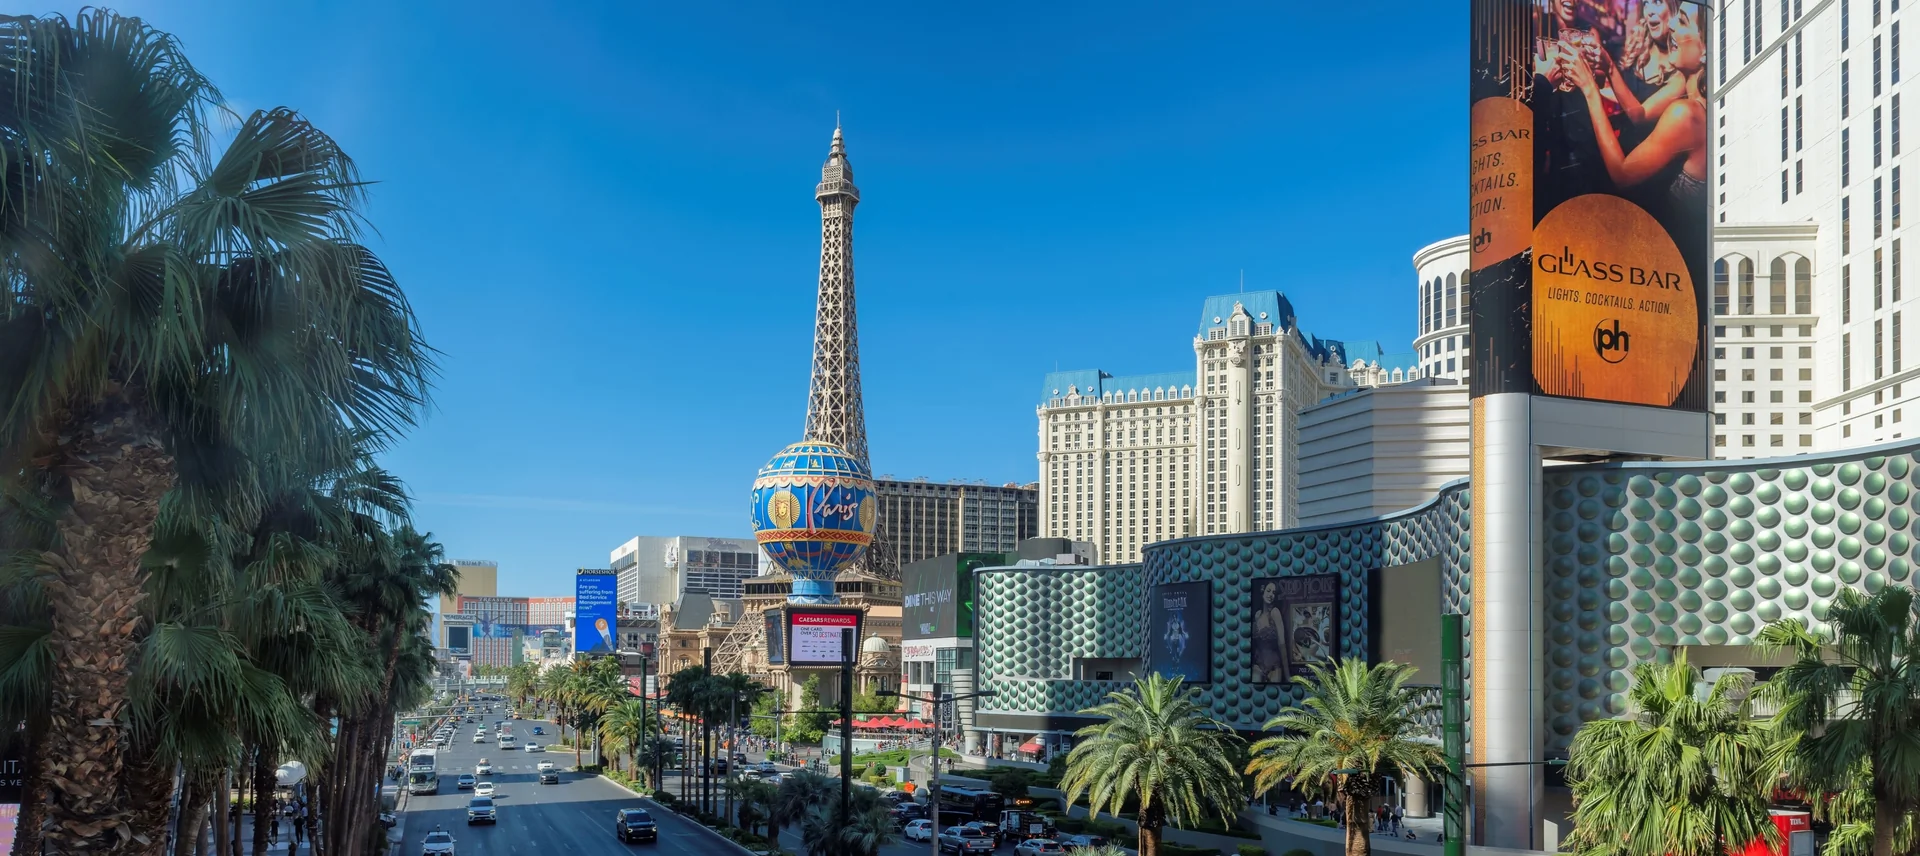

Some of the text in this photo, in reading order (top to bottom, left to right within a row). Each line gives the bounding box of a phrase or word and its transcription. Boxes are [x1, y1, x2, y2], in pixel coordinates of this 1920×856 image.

[1491, 129, 1530, 142] BAR
[1472, 152, 1504, 175] GHTS.
[1538, 250, 1683, 291] GLASS BAR
[1548, 287, 1672, 315] LIGHTS. COCKTAILS. ACTION.
[1597, 319, 1629, 357] ph
[808, 476, 858, 534] Paris
[905, 589, 952, 608] DINE THIS WAY
[0, 760, 20, 774] IT
